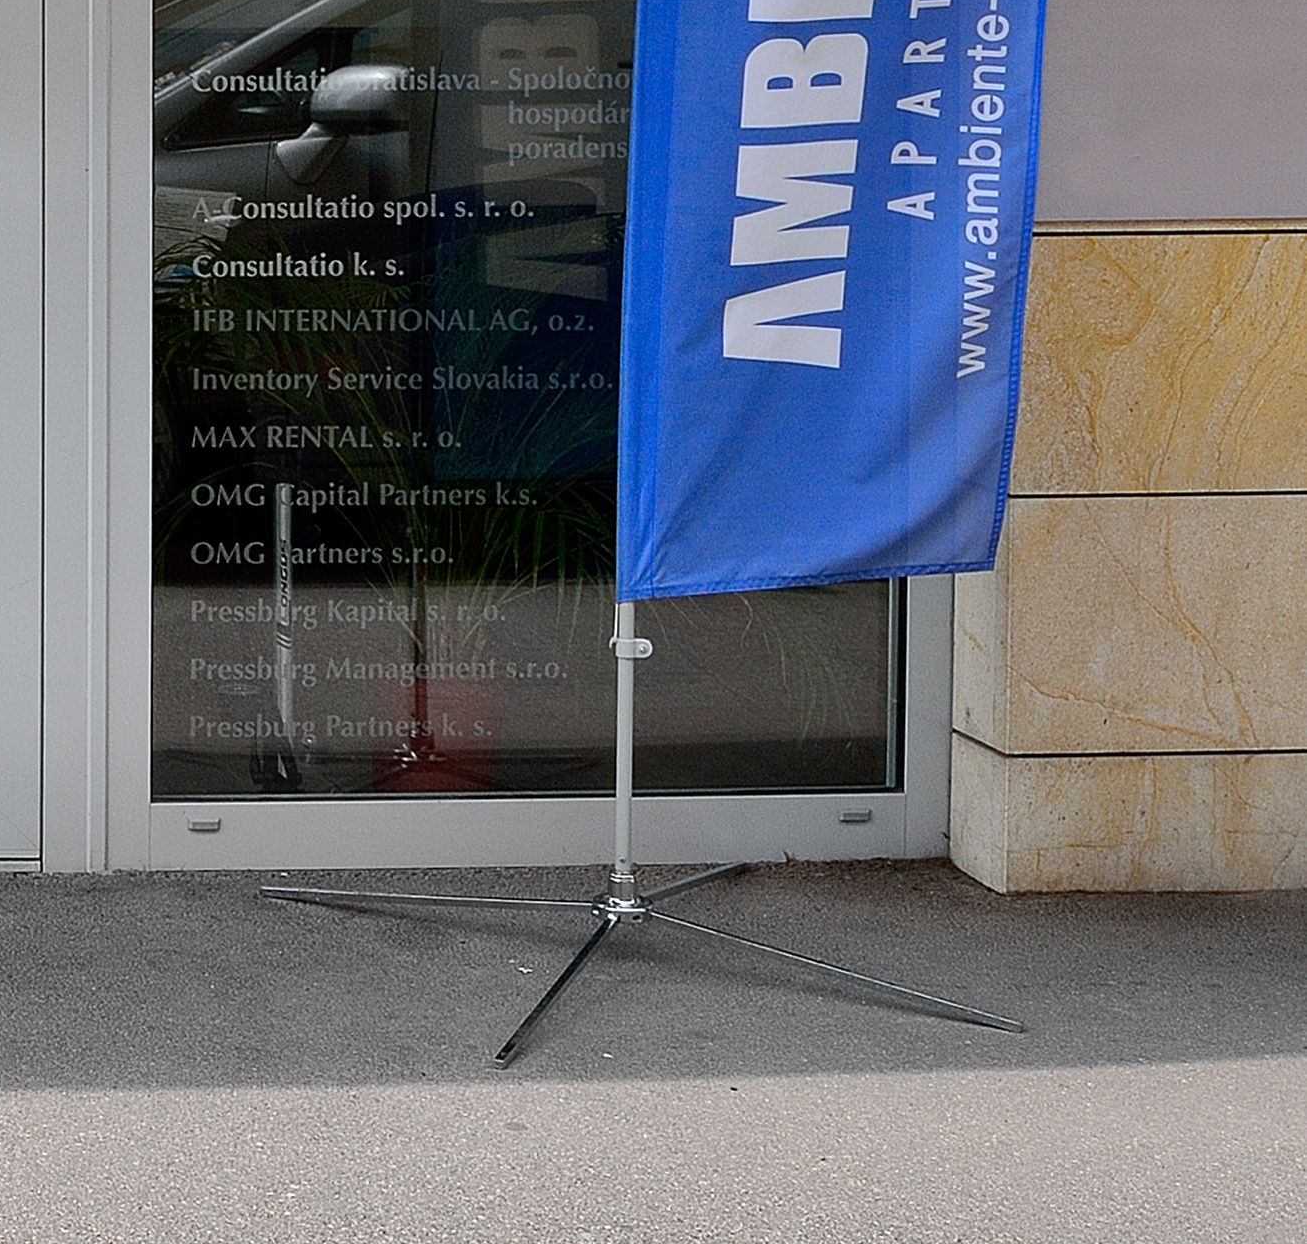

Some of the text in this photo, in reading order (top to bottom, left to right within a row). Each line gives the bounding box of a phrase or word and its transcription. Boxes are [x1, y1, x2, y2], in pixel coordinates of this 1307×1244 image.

[191, 66, 342, 93] Consultati
[193, 194, 535, 224] A-Consultatio spol. s. r. o.
[192, 252, 405, 277] Consultatio k. s.
[193, 309, 595, 335] IFB INTERNATIONAL AG, o.z.
[193, 366, 614, 397] Inventory Service Slovakia s.r.o.
[191, 426, 462, 448] MAX RENTAL s. r. o.
[191, 482, 538, 513] OMG Capital Partners k.s.
[191, 541, 454, 565] OMG artners s.r.o.
[327, 599, 416, 629] Kapital
[326, 658, 496, 687] Management
[506, 661, 568, 679] s.r.o.
[326, 715, 432, 738] Partners
[442, 713, 464, 738] k.
[473, 719, 493, 738] s.
